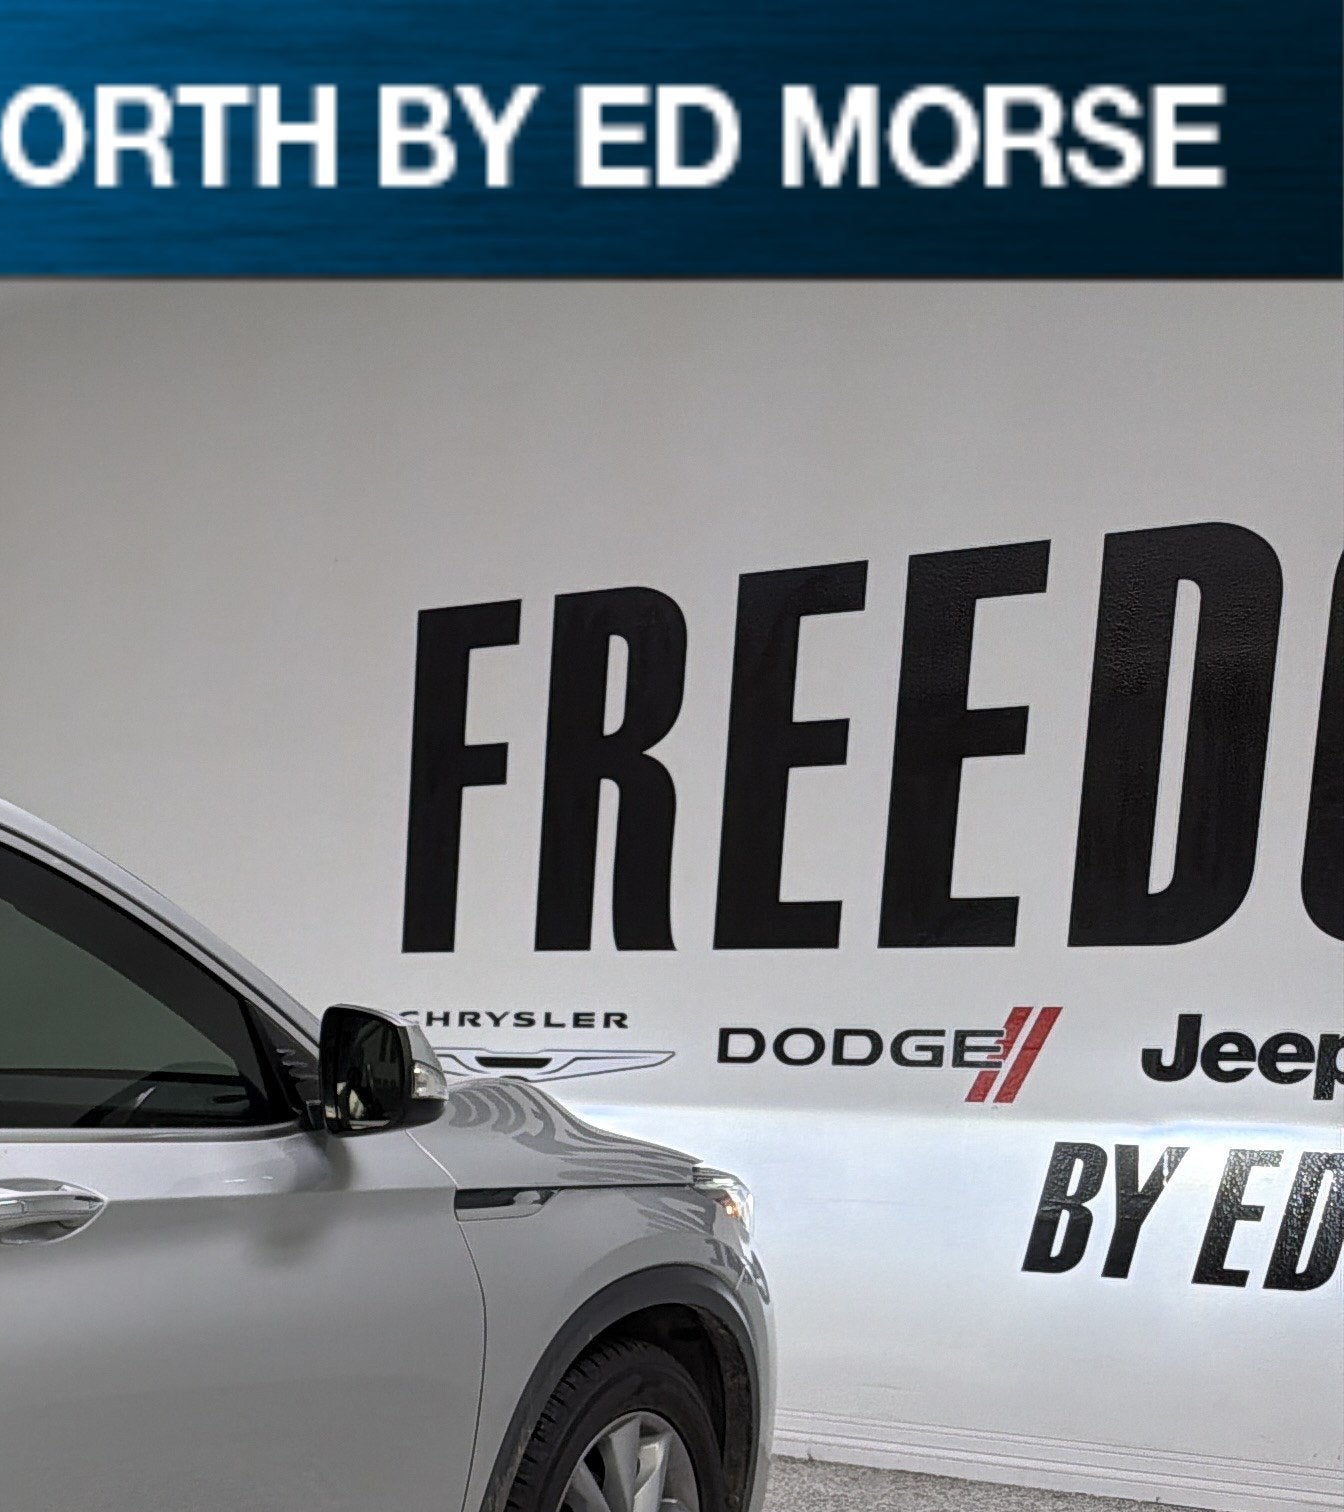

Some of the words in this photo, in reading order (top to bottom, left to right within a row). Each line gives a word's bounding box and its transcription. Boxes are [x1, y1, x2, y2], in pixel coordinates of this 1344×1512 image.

[402, 522, 1344, 953] FREED
[717, 1027, 1005, 1069] DODGE
[1021, 1142, 1191, 1279] BY
[1191, 1148, 1344, 1292] ED
